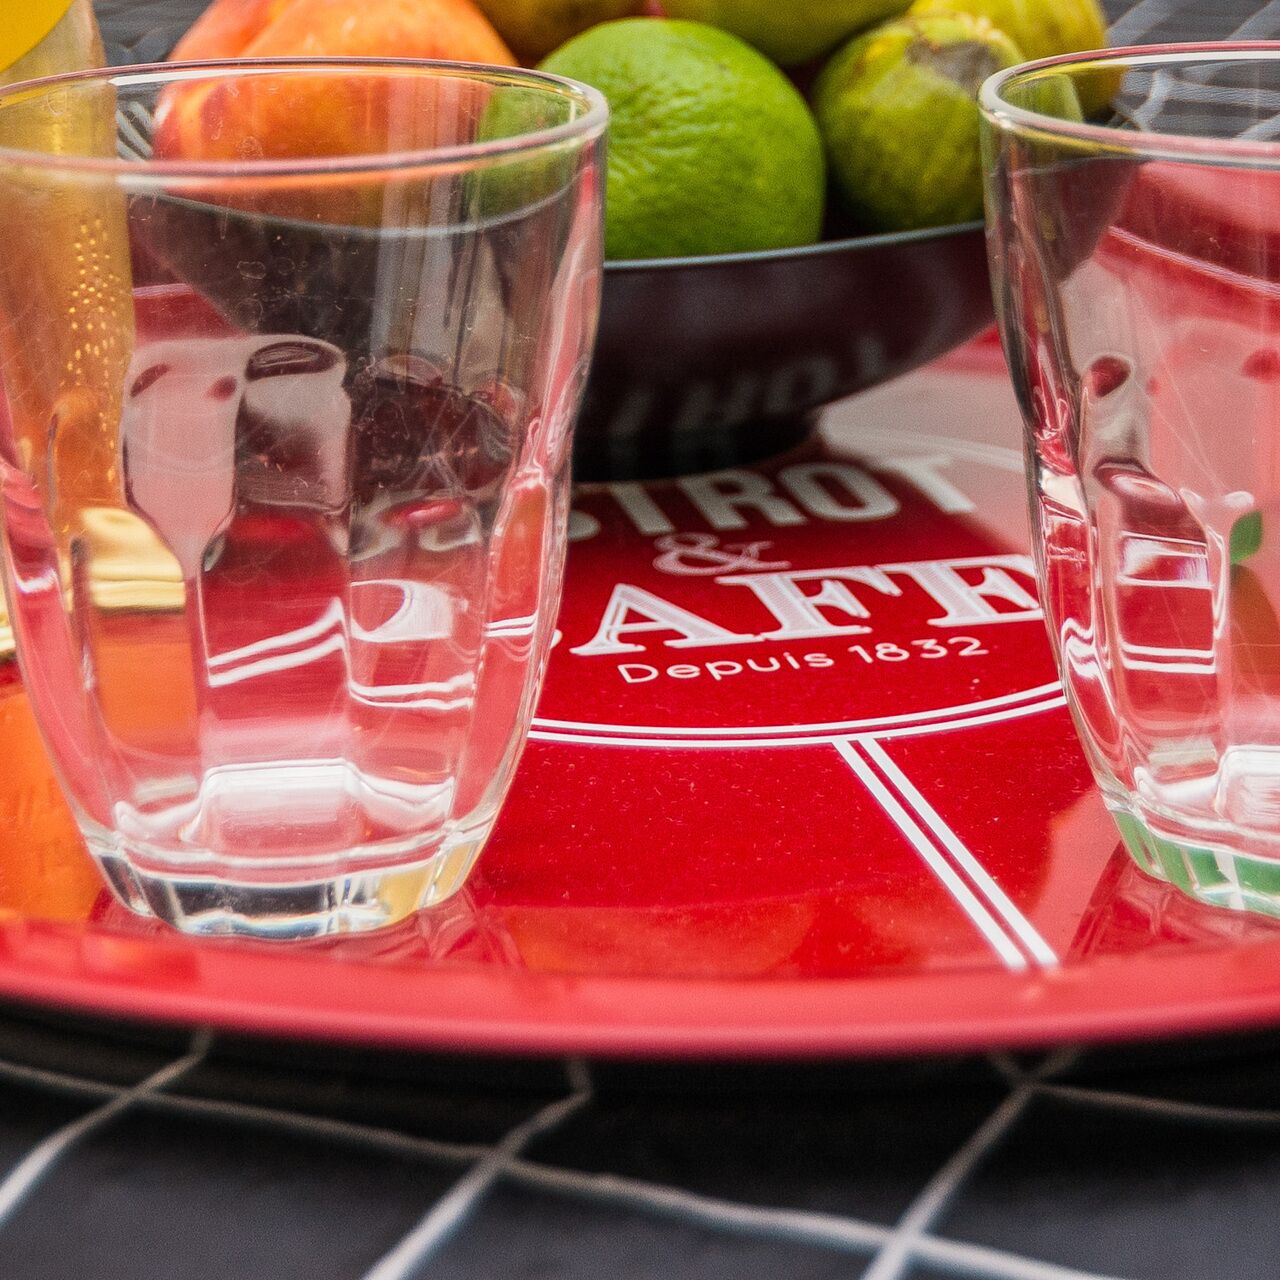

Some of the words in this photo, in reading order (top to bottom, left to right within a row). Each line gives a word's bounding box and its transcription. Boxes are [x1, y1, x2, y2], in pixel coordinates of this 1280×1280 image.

[651, 531, 793, 577] &
[616, 648, 835, 685] Depuis
[846, 635, 990, 666] 1832
